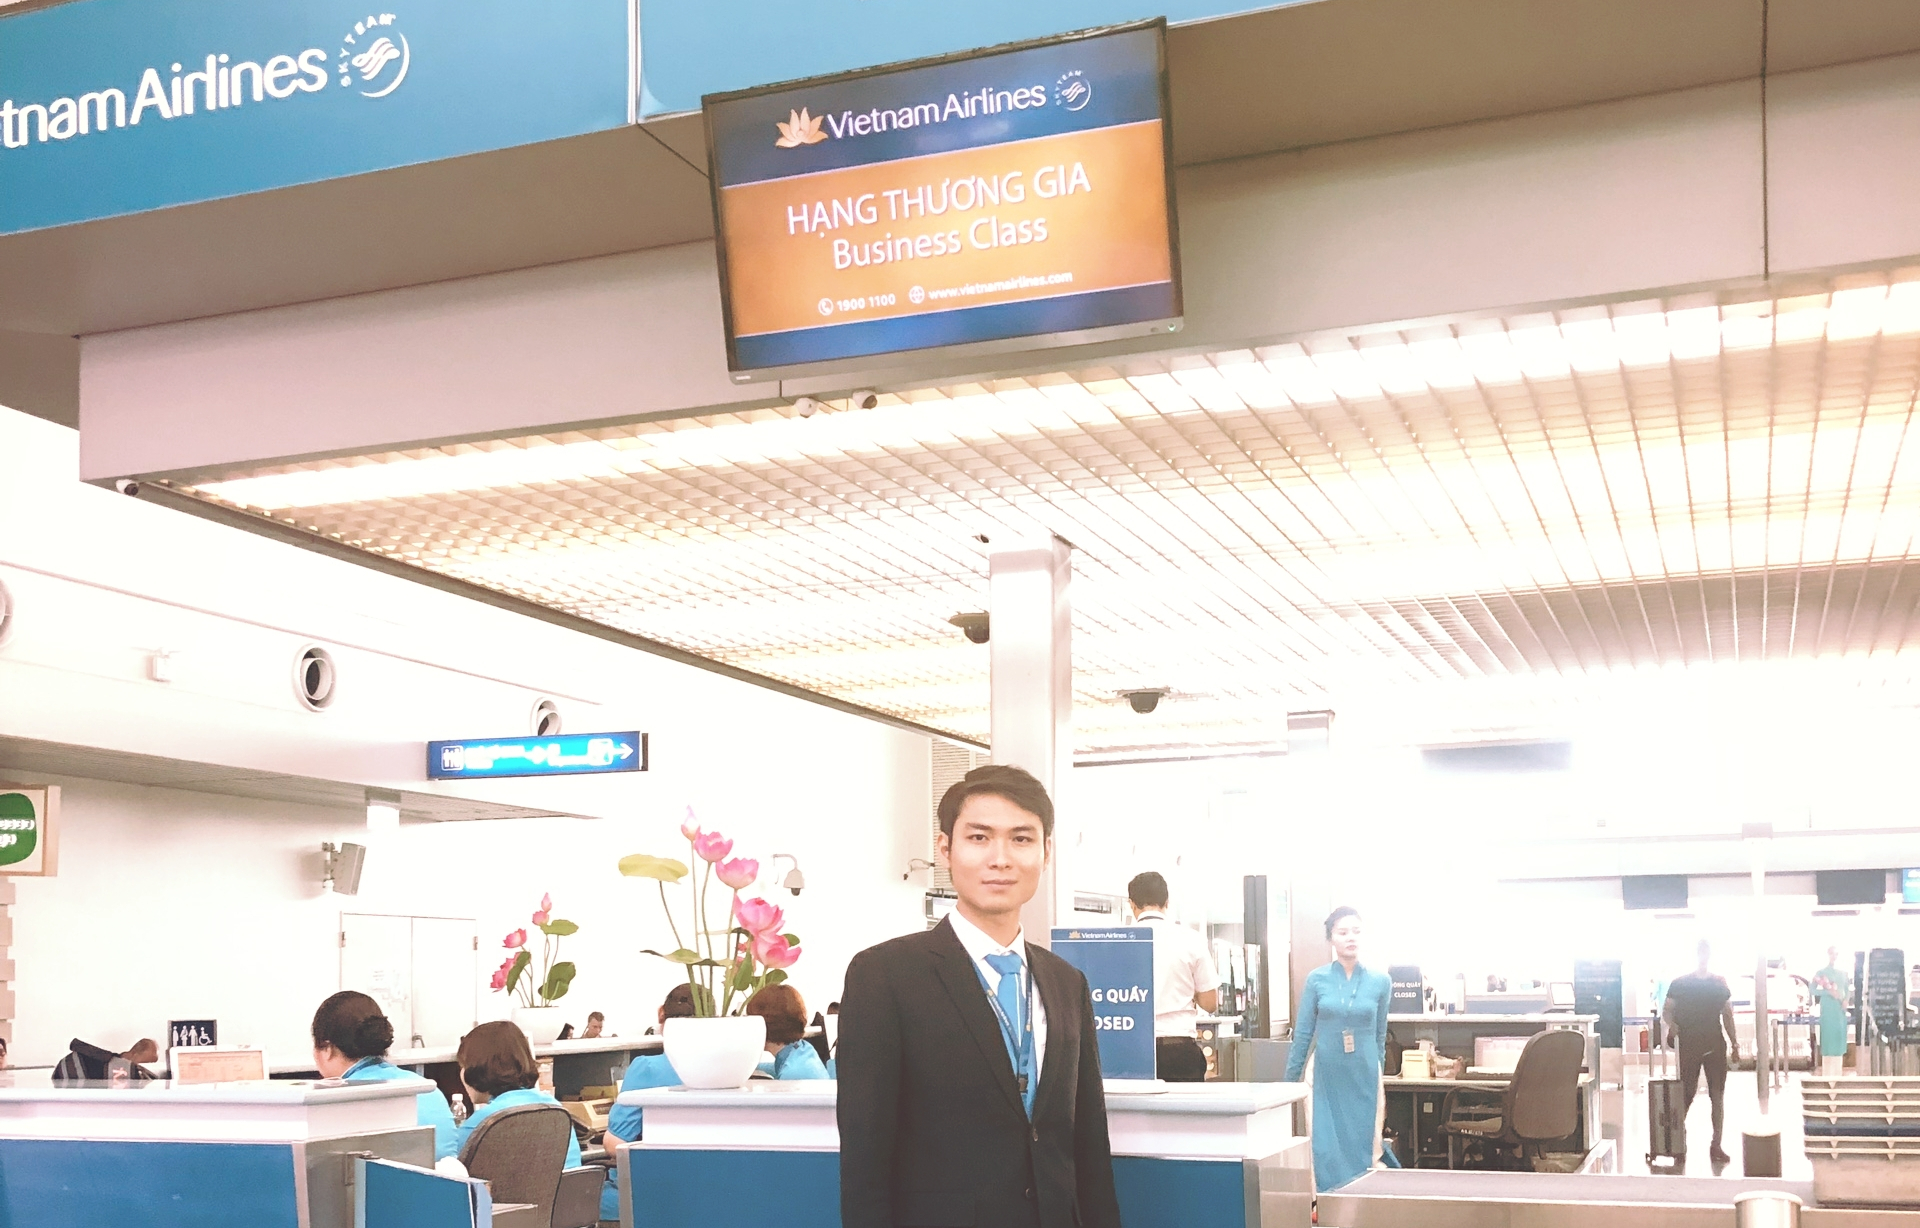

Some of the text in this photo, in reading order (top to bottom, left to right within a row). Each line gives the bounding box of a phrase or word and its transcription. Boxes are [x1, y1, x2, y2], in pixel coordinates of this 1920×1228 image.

[0, 49, 328, 149] tnam Airlines
[827, 85, 1046, 139] Vietnam Airlines
[787, 162, 1092, 238] HẠNG THƯƠNG GIA
[833, 216, 1048, 270] Business Class
[837, 271, 1073, 312] 1900 1100 www.vietnamairlines.com
[1094, 1015, 1134, 1031] OSED
